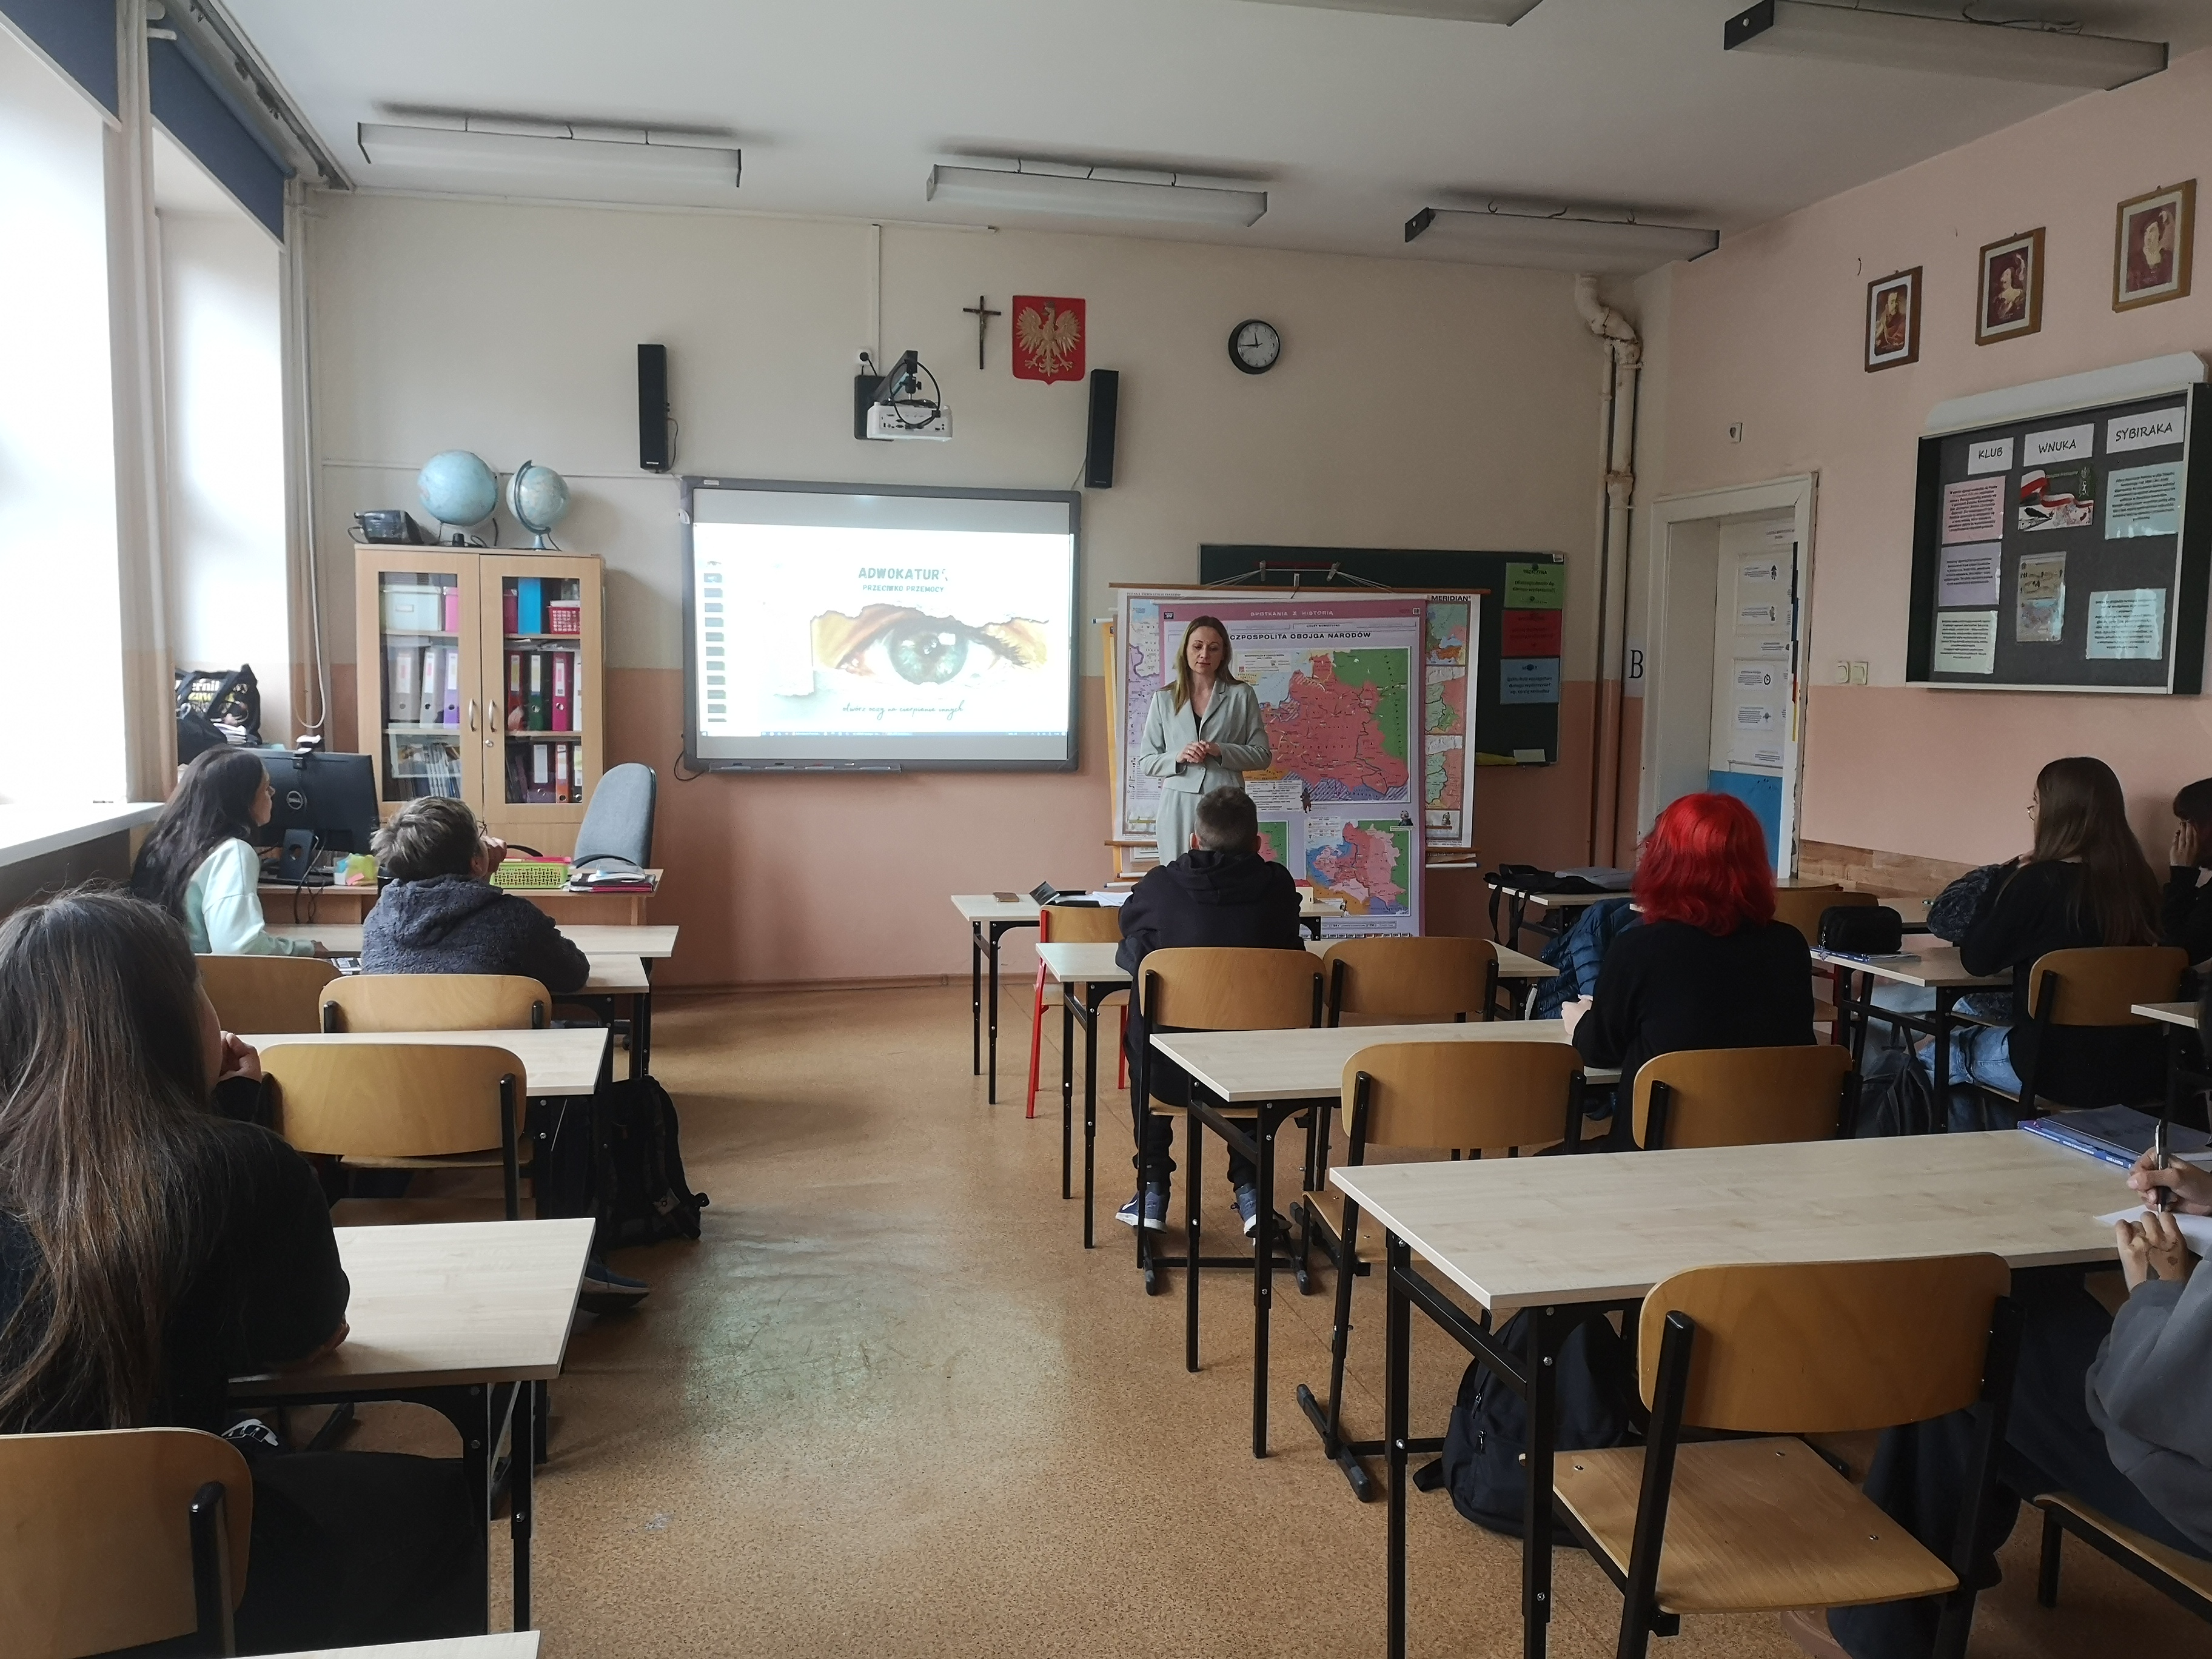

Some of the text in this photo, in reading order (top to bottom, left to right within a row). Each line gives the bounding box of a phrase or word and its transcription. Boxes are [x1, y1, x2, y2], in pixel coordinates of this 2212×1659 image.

[1978, 422, 2173, 460] KLUB WNUKA SYBIRAKA
[858, 568, 948, 581] ADWOKATUR
[1629, 649, 1643, 678] B
[842, 702, 866, 712] otwórz
[868, 707, 885, 720] oczy
[939, 700, 965, 720] innych
